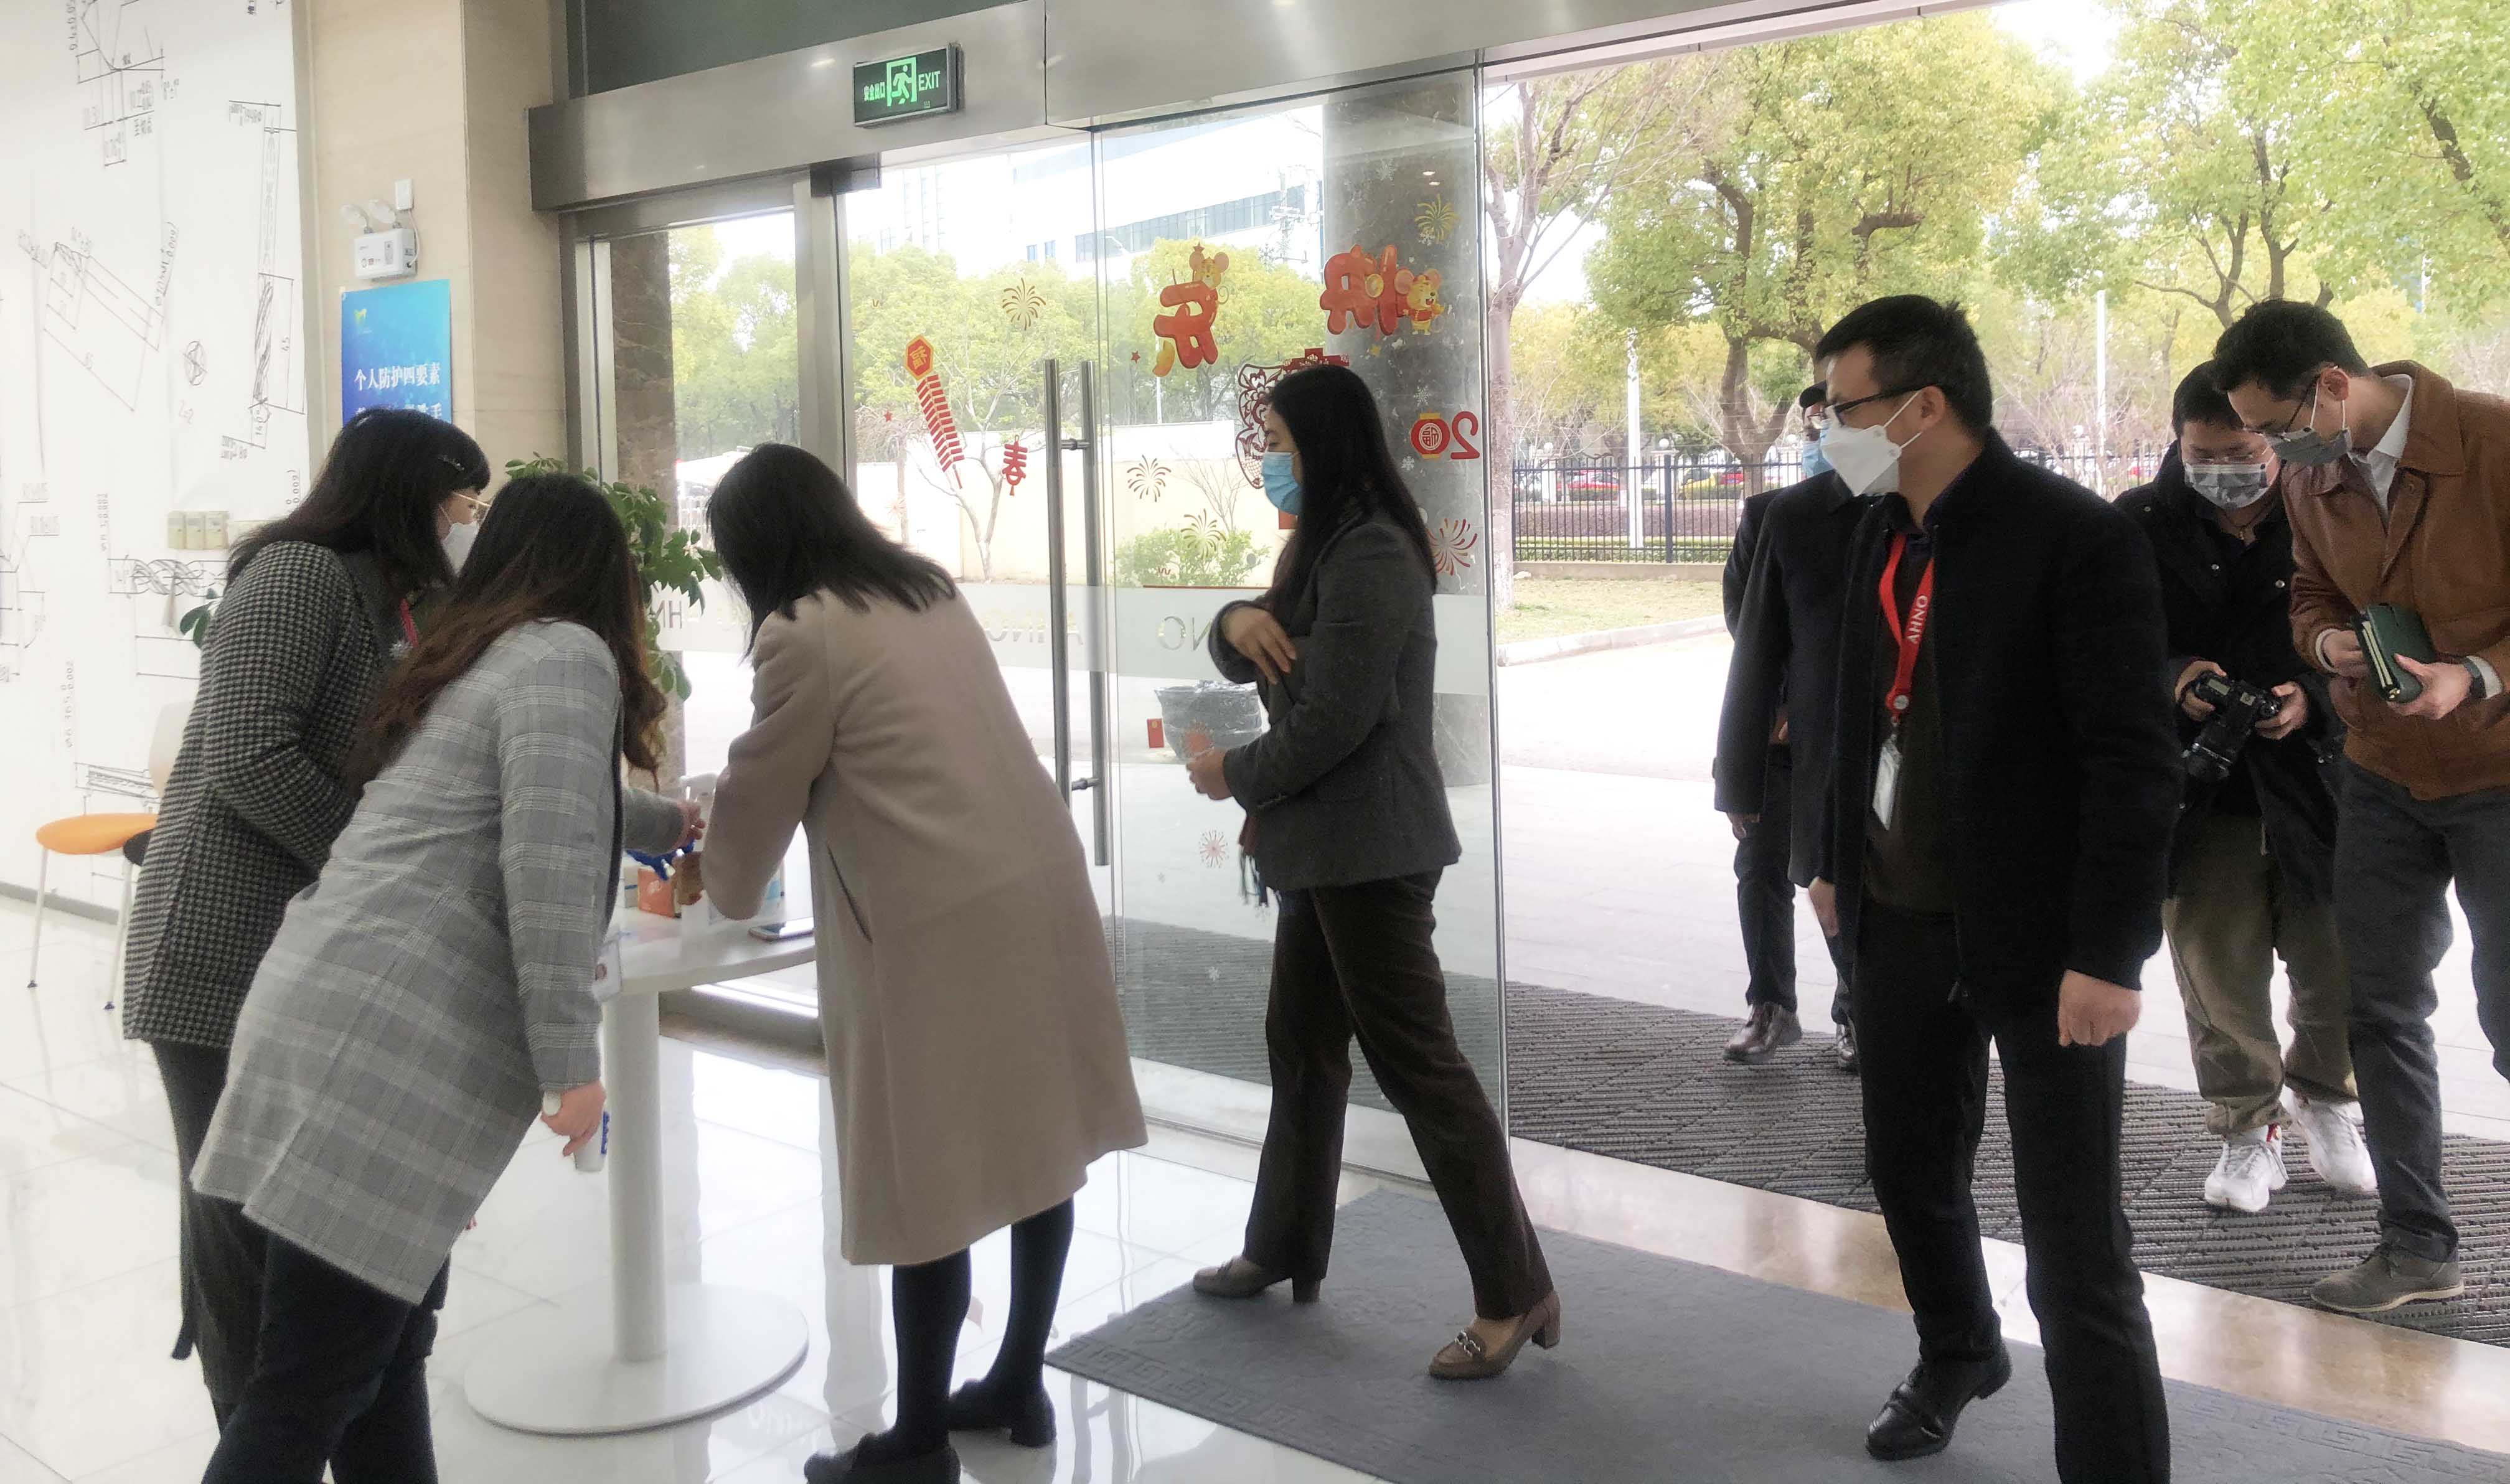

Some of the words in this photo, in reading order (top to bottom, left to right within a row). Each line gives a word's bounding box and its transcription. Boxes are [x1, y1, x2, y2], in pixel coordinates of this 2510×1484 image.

[918, 70, 941, 92] EXIT
[354, 362, 441, 392] 个人防护四要素
